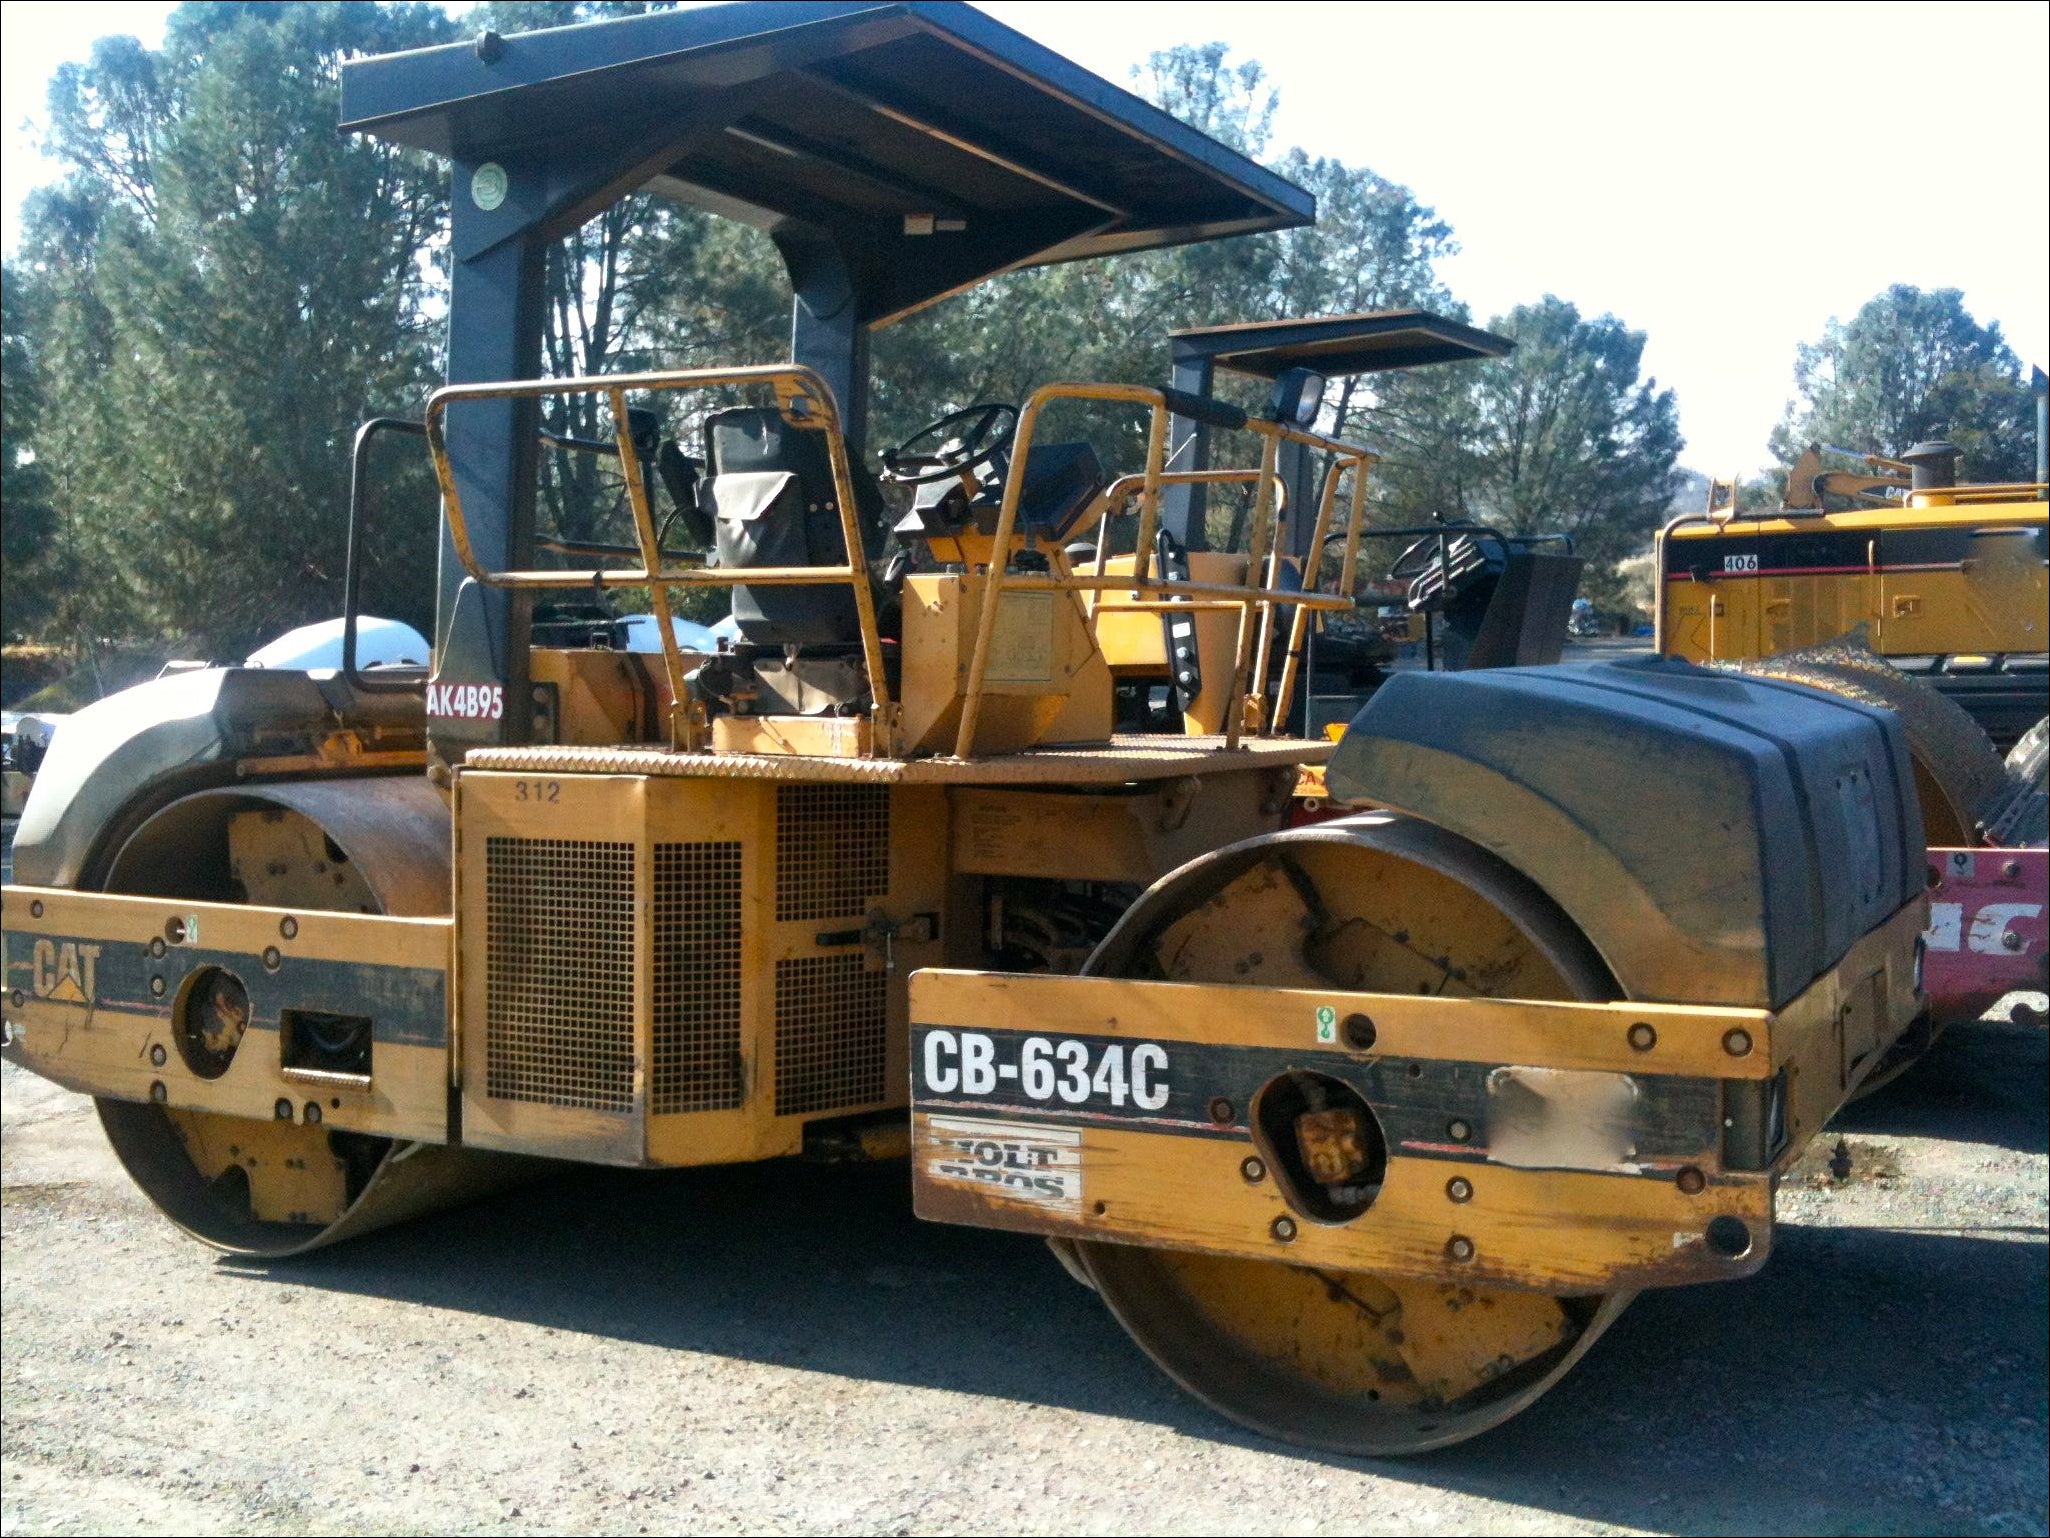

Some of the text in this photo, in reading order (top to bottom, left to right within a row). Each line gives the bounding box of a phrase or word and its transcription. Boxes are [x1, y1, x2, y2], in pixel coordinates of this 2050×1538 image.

[1725, 555, 1757, 571] 406
[427, 685, 504, 719] AK4B95
[515, 780, 560, 804] 312
[33, 939, 101, 1003] CAT
[924, 1029, 1169, 1110] CB-634C
